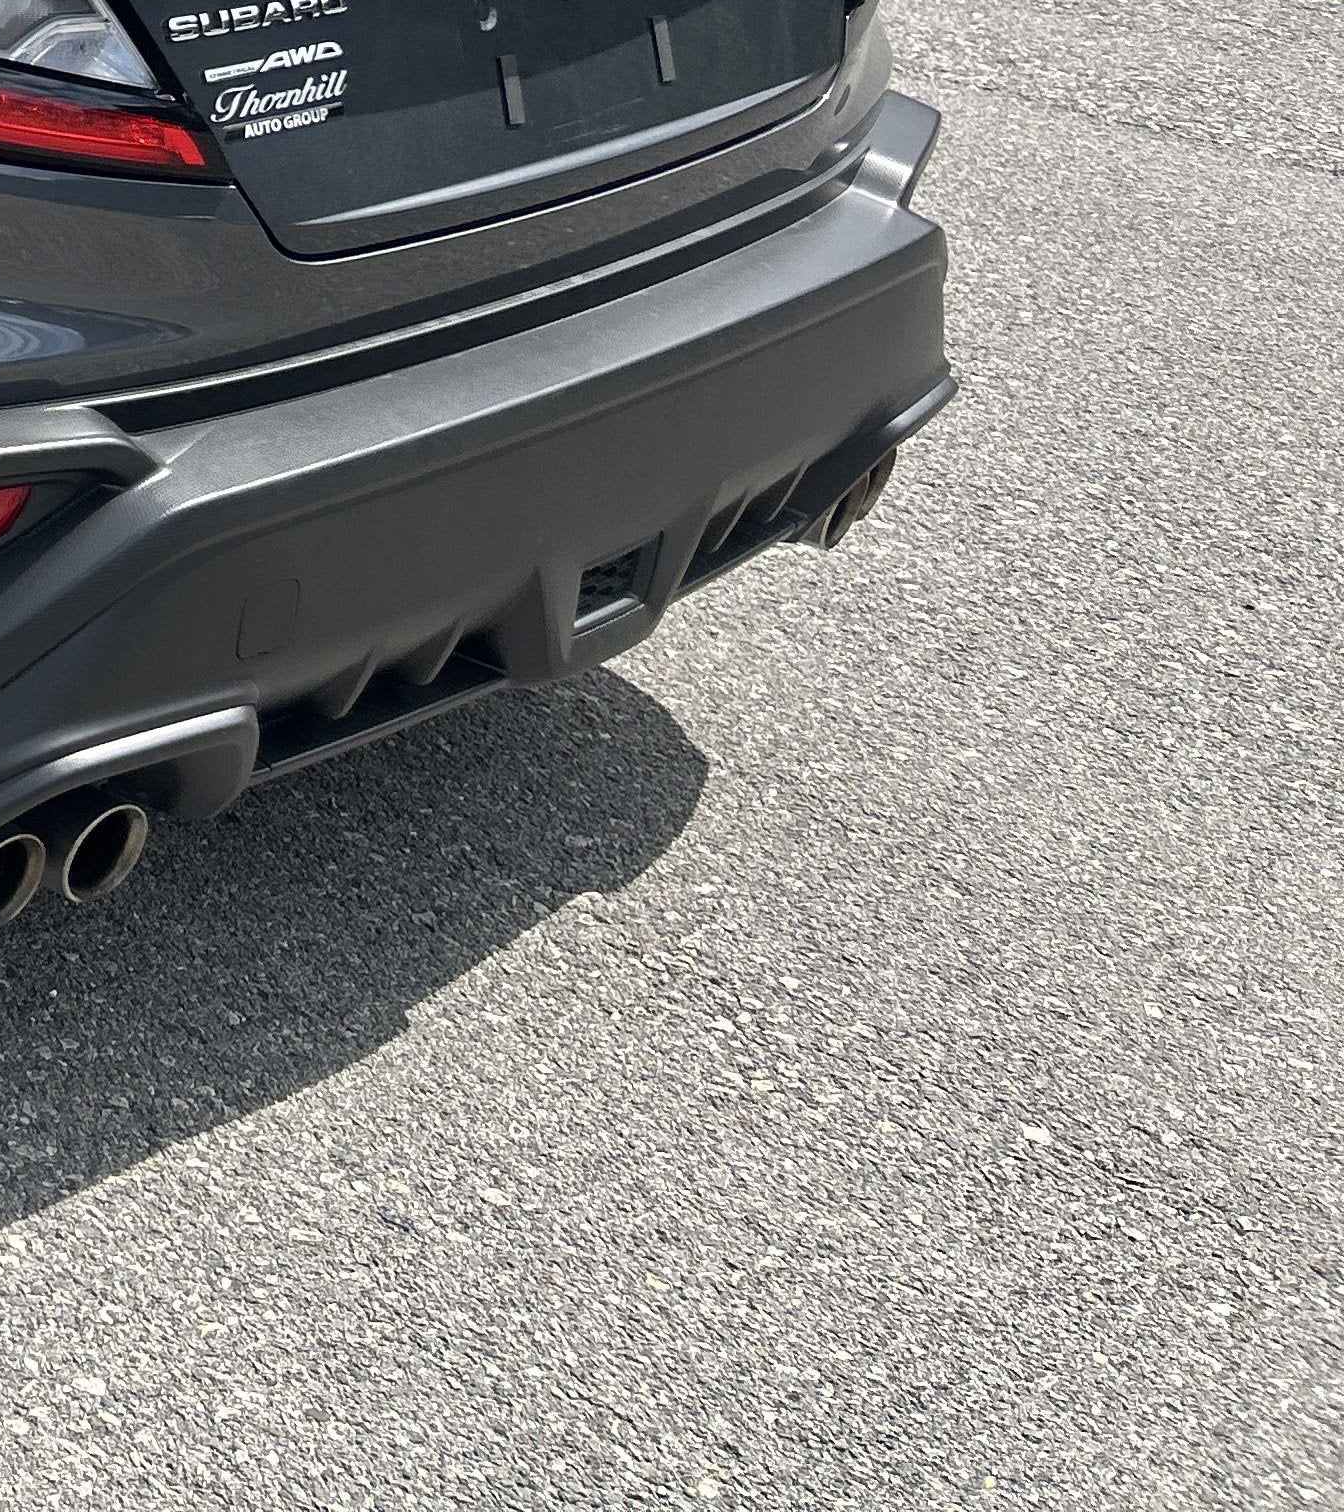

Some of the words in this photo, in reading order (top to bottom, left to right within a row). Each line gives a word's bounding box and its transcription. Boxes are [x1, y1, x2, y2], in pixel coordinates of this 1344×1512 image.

[260, 41, 344, 73] AWD
[210, 69, 348, 123] Thornhill
[244, 113, 282, 139] AUTO
[283, 107, 329, 131] GROUP
